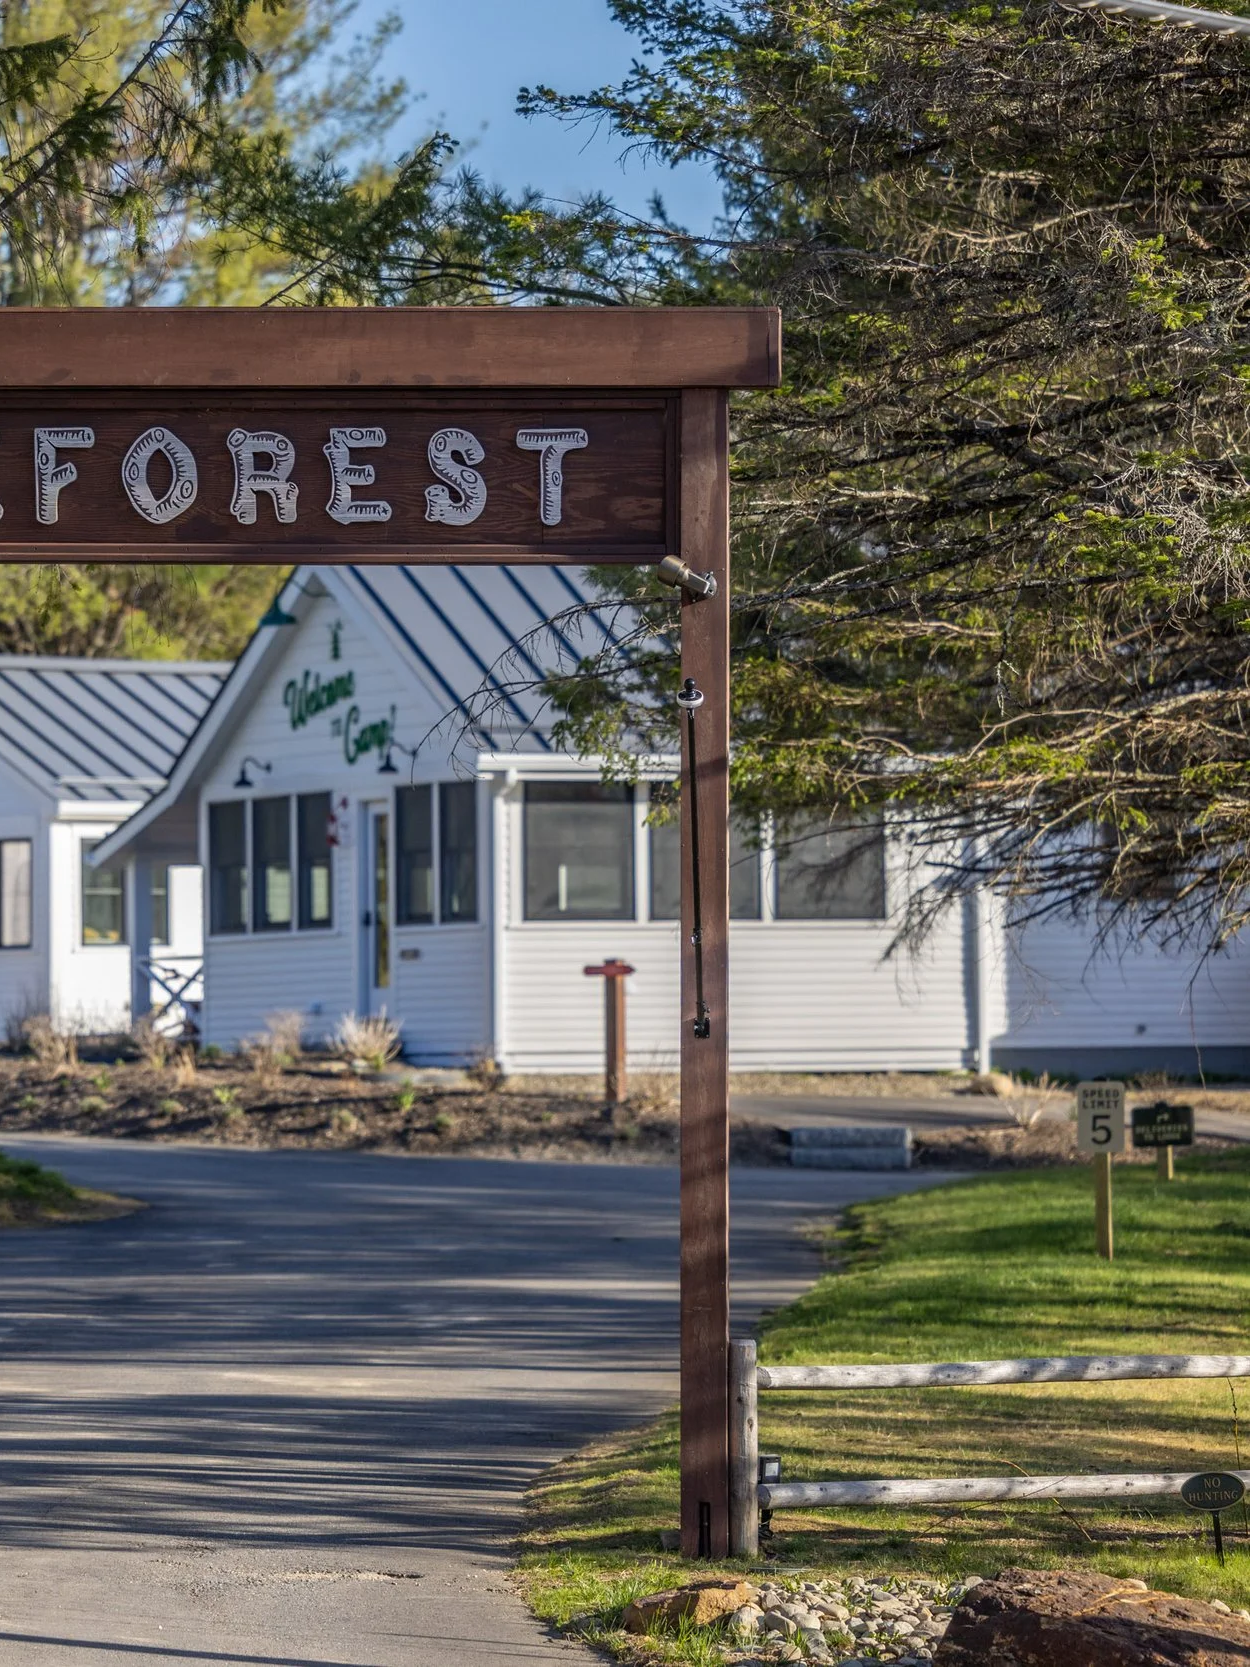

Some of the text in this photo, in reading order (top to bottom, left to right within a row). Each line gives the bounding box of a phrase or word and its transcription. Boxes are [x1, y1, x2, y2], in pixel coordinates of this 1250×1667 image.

[283, 669, 354, 731] Welcome
[1082, 1089, 1120, 1099] SPEED
[1082, 1100, 1120, 1109] LIMIT
[1091, 1114, 1112, 1145] 5
[1203, 1477, 1221, 1489] NO
[1188, 1490, 1238, 1502] HUNTING
